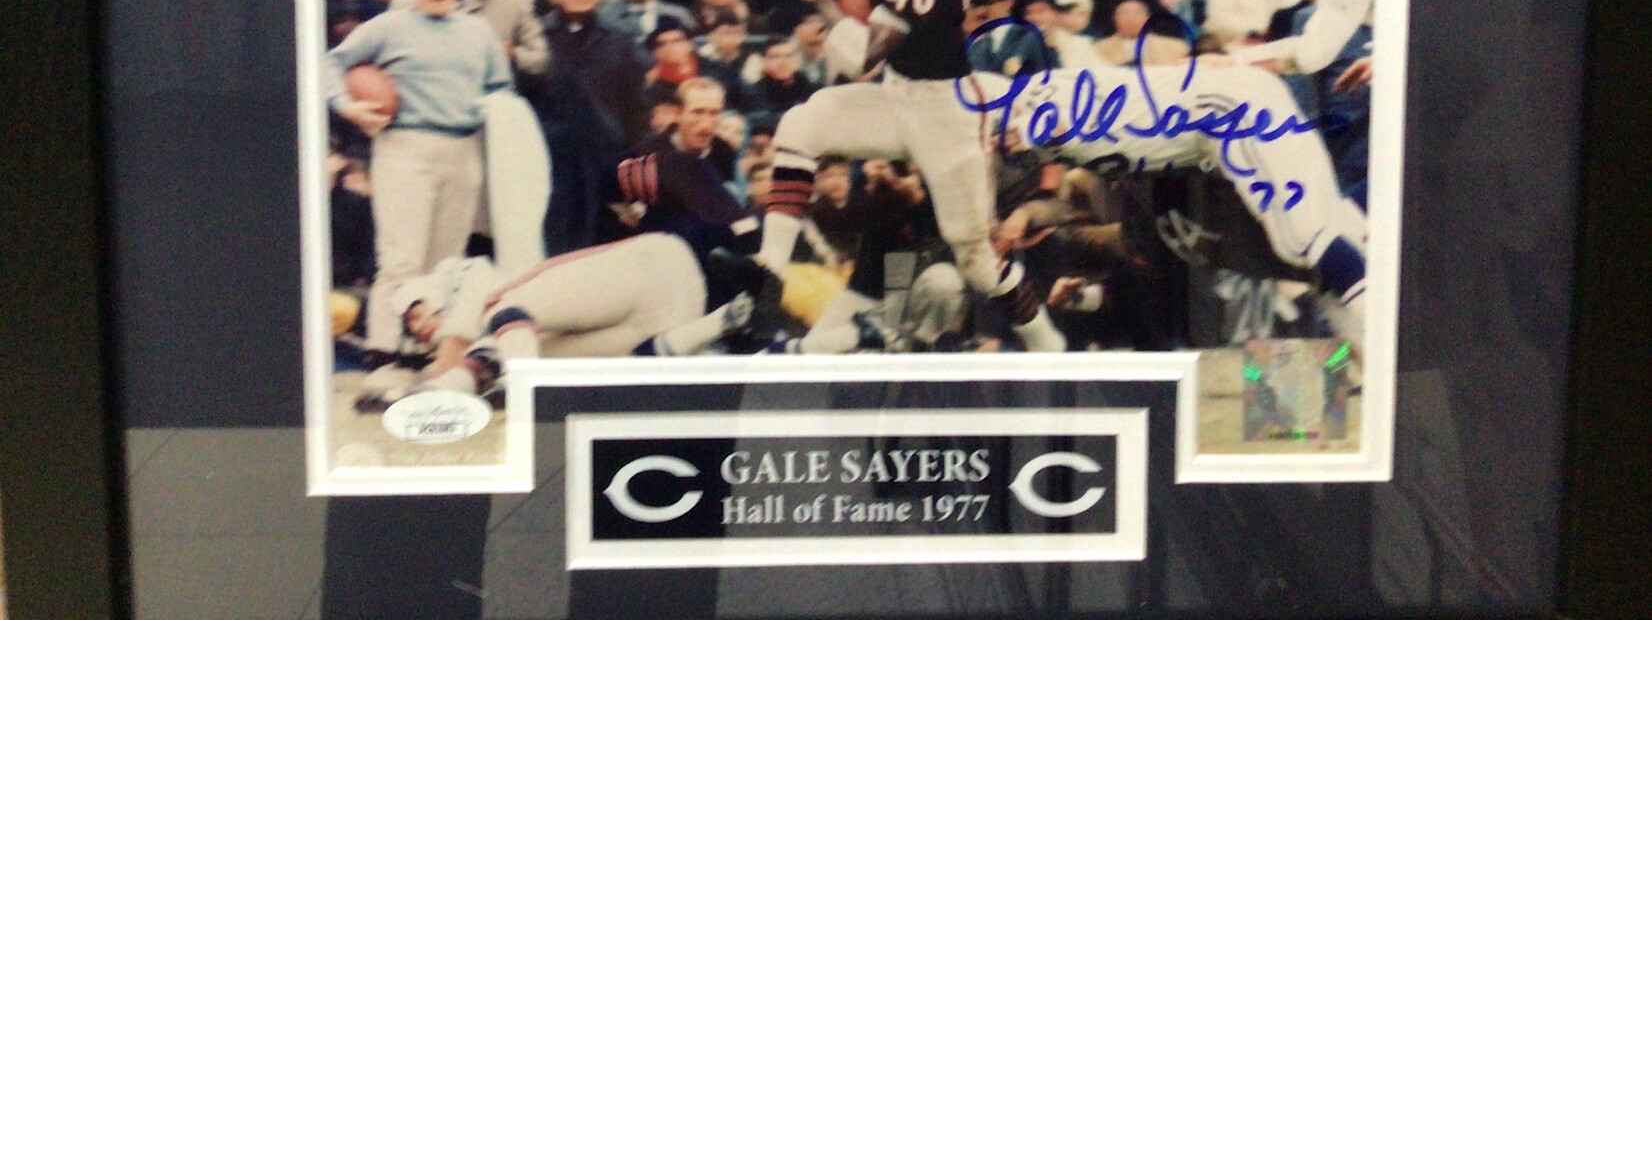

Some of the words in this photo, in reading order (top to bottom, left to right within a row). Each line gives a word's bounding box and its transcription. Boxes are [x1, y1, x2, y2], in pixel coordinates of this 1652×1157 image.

[720, 450, 832, 485] GALE
[839, 449, 992, 483] SAYERS
[720, 495, 785, 525] Hall
[792, 494, 826, 524] of
[831, 495, 912, 523] Fame
[921, 494, 991, 522] 1977
